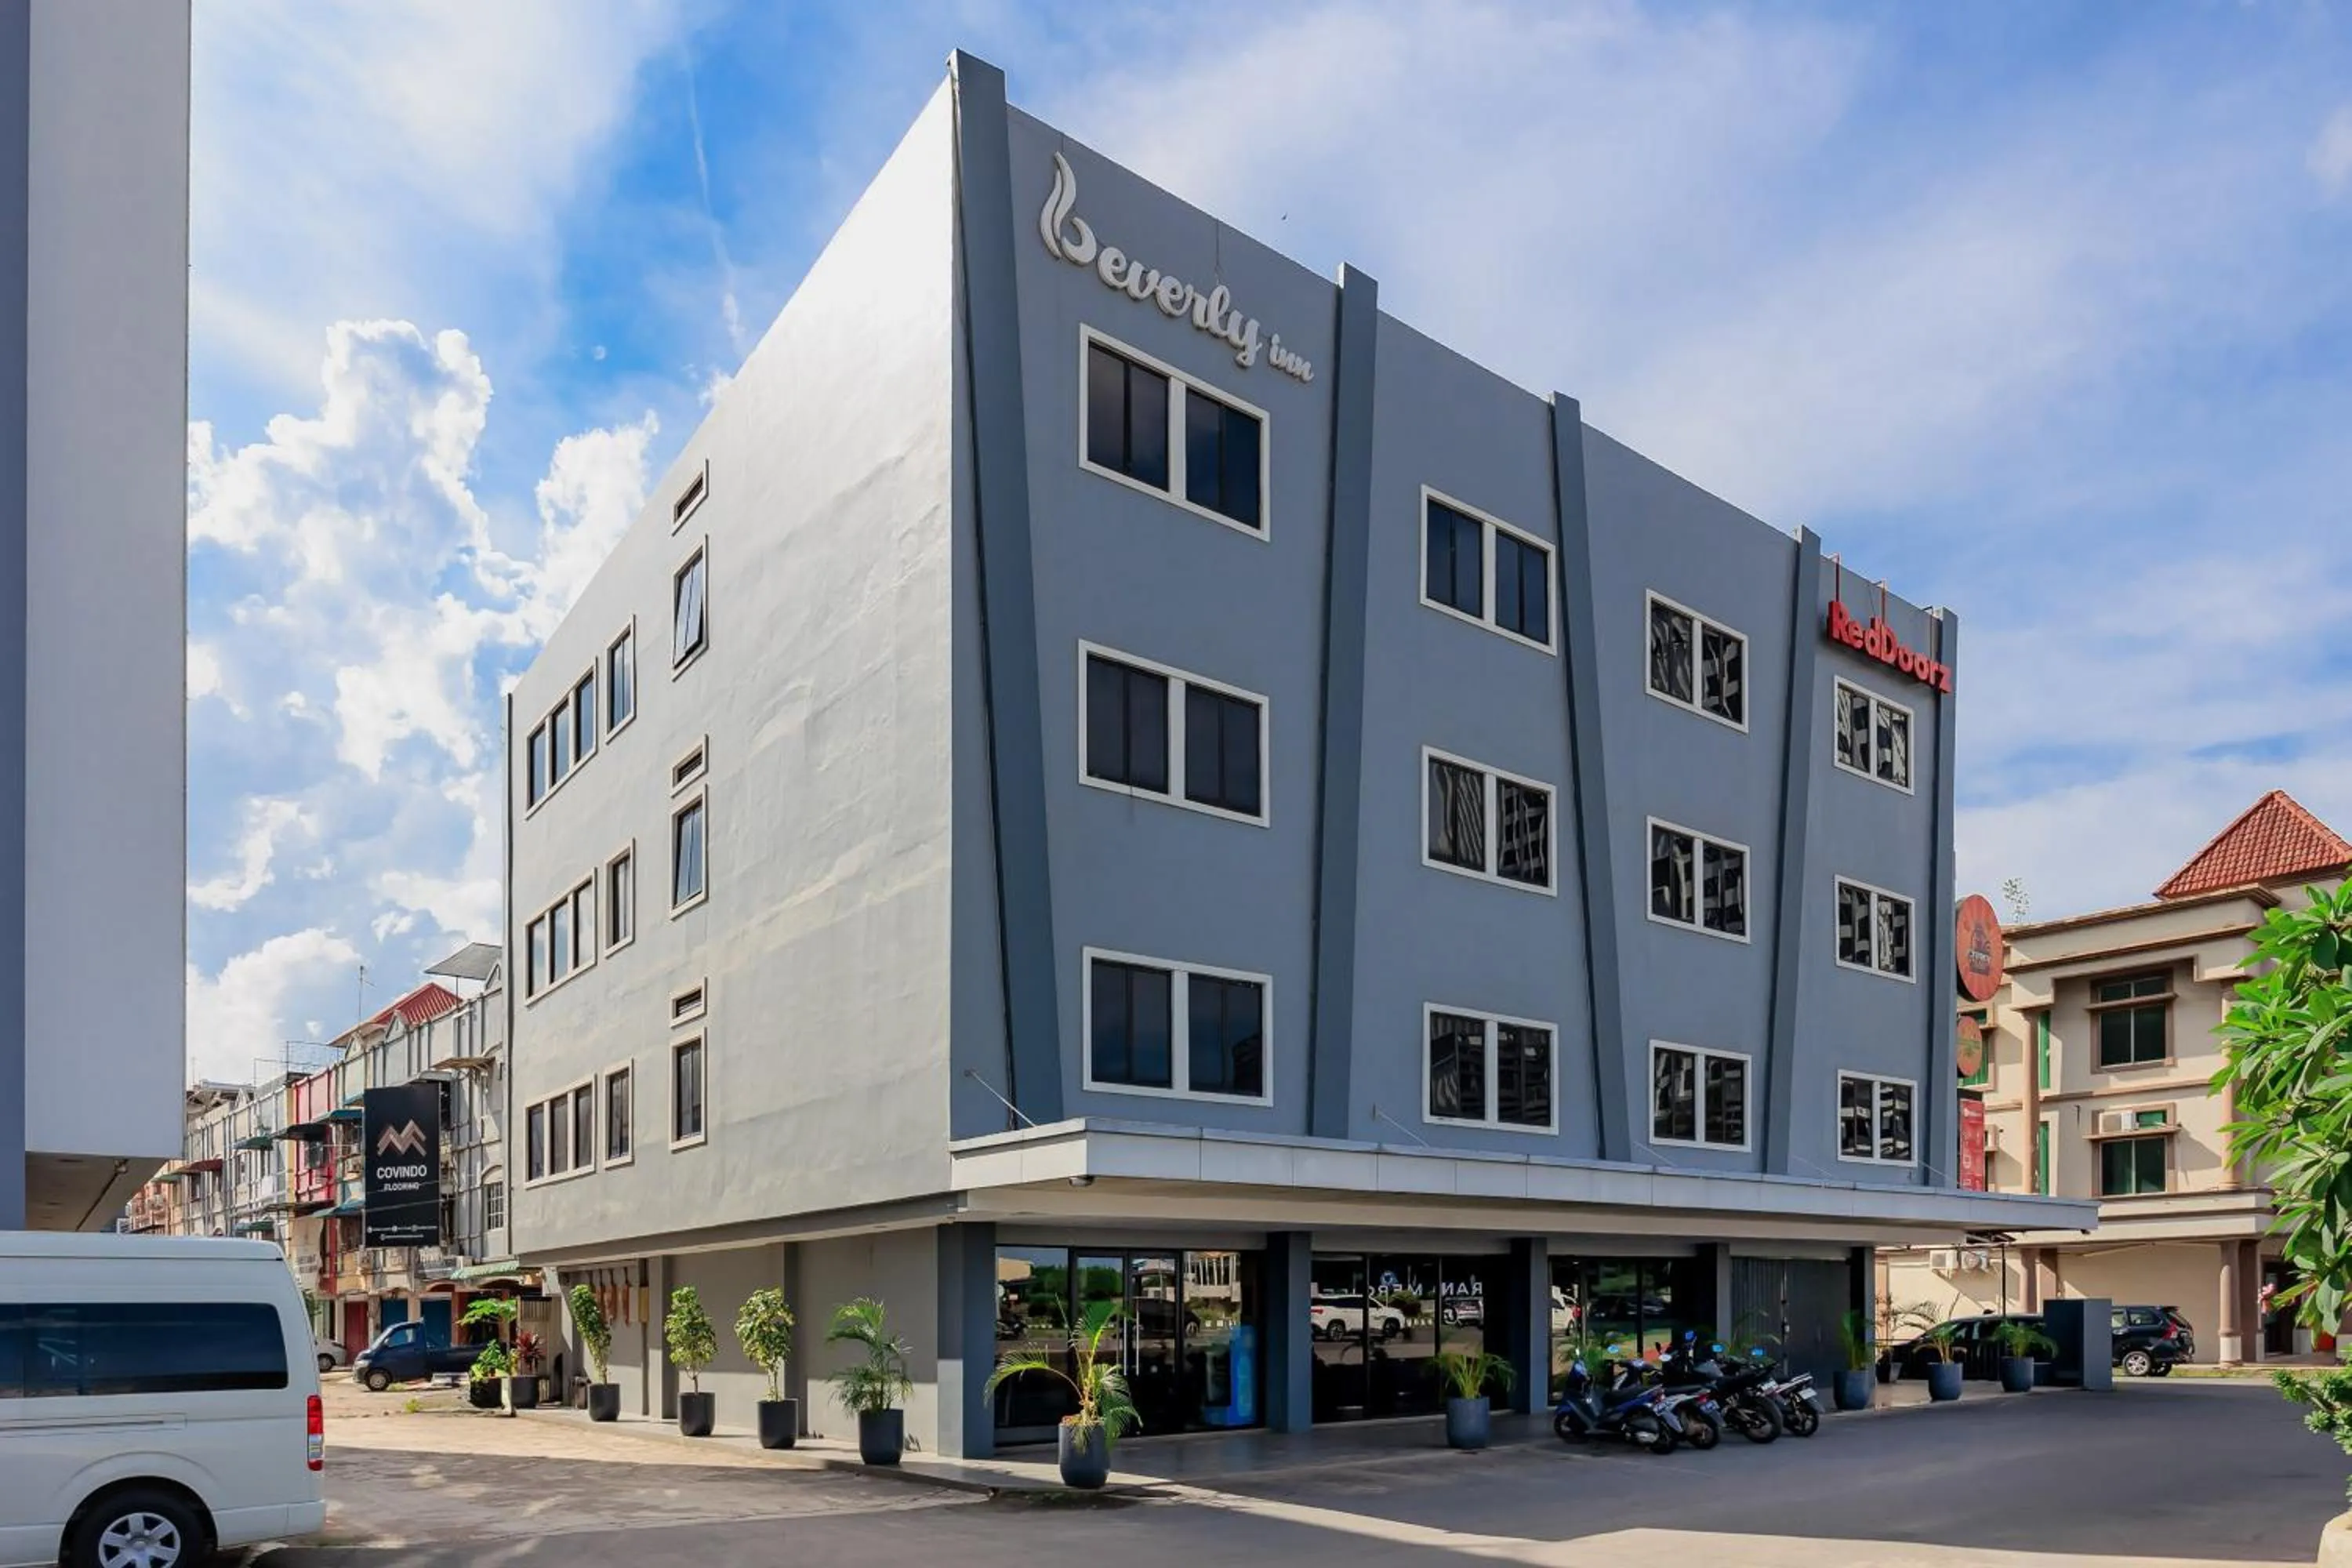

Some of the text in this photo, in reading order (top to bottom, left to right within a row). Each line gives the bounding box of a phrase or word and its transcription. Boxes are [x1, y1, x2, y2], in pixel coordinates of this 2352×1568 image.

[1269, 332, 1315, 383] inn
[1827, 601, 1953, 694] RedDoorz
[376, 1164, 427, 1179] COVINDO
